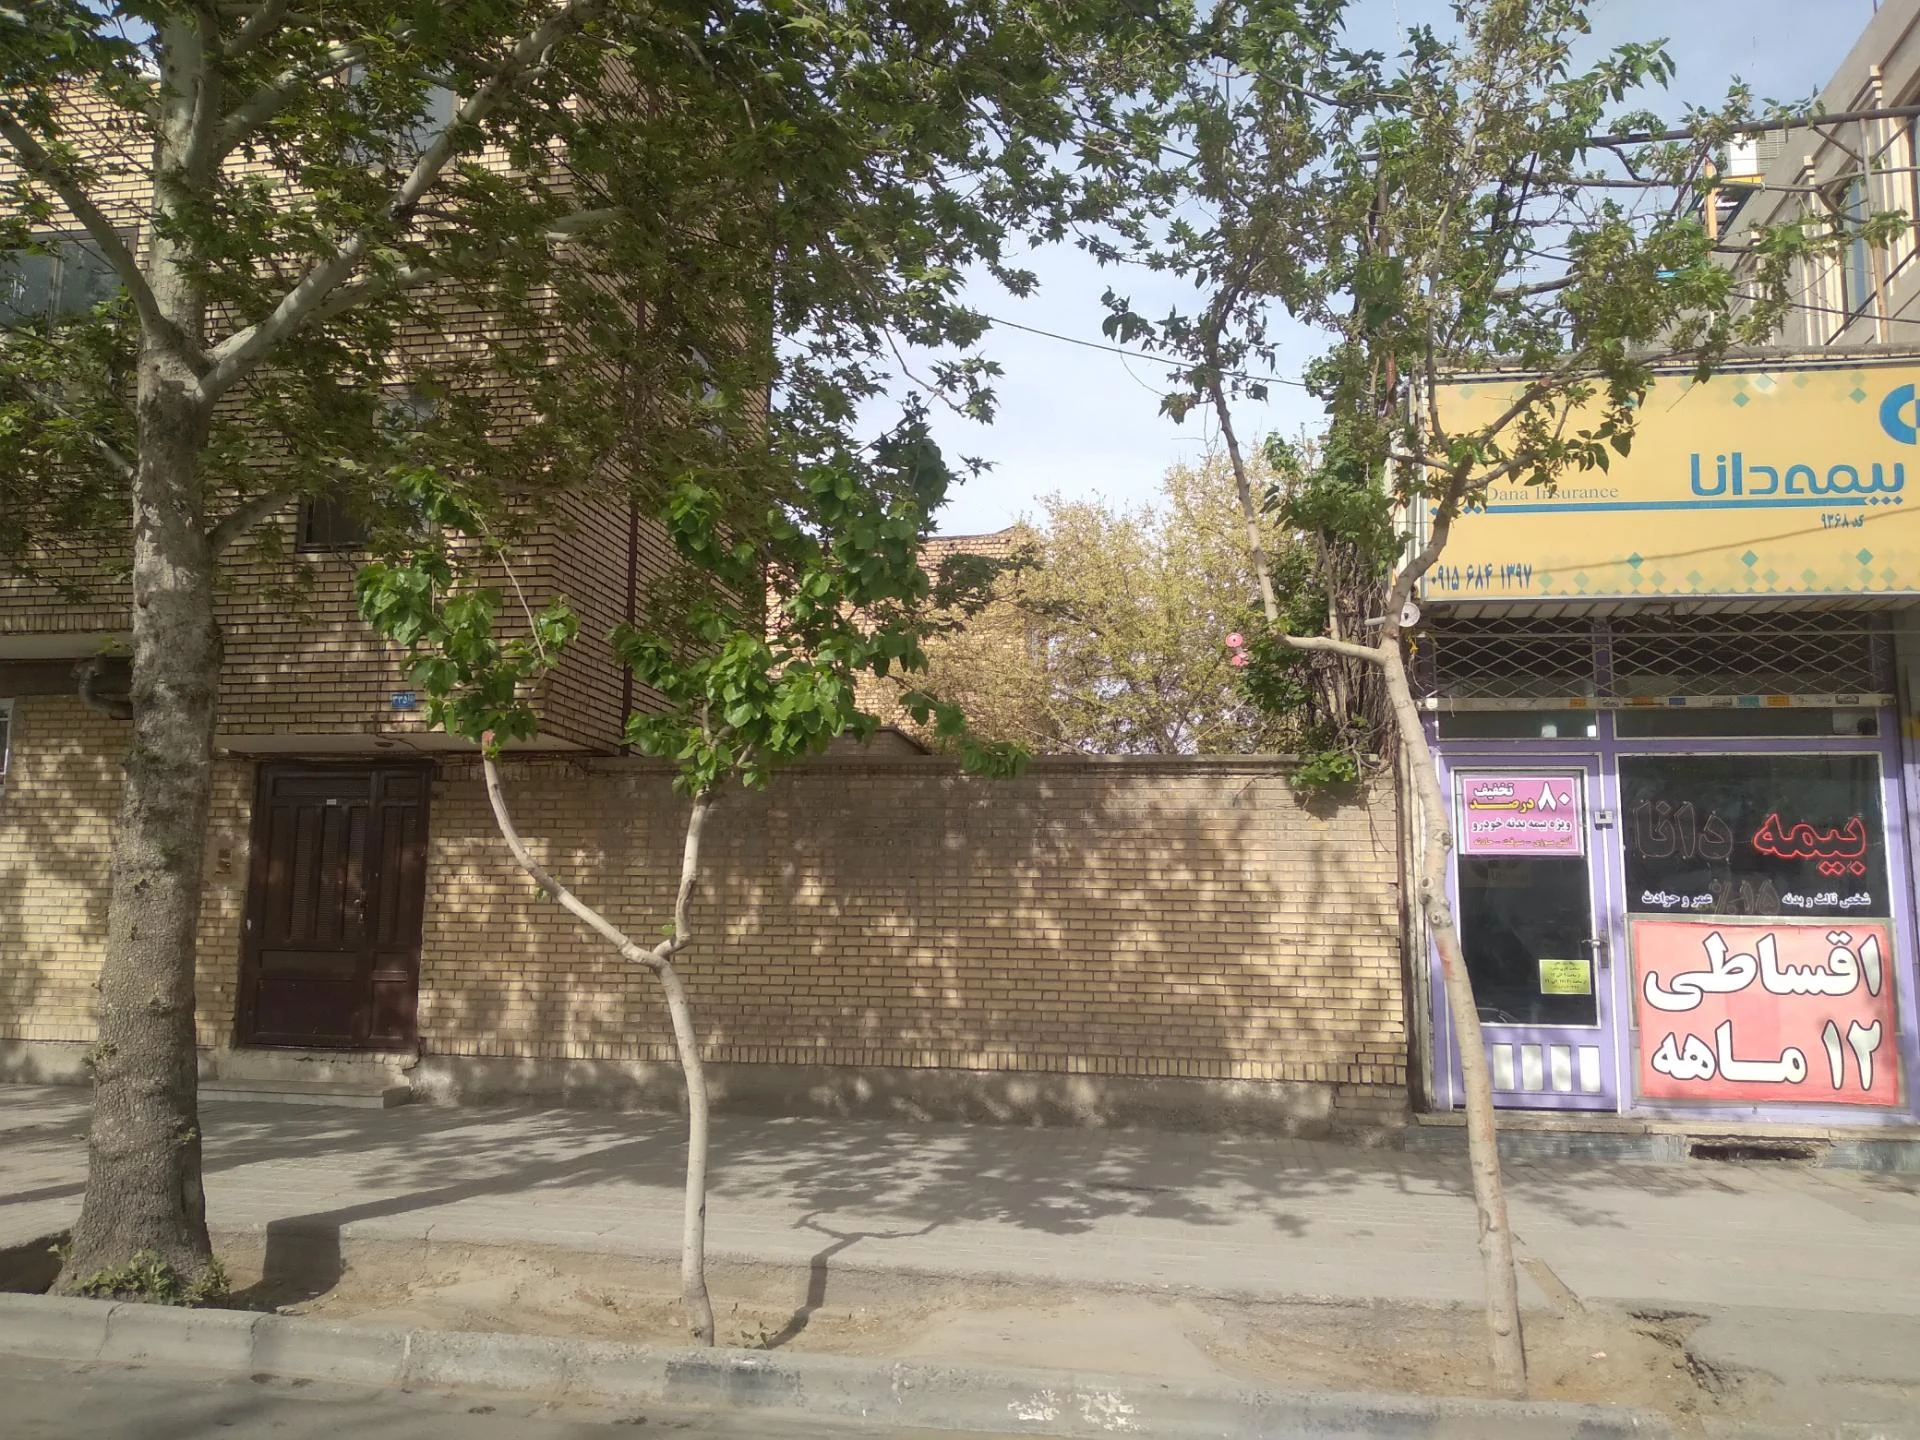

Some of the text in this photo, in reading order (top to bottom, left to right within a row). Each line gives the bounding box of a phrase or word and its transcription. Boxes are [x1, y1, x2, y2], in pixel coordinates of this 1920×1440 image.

[1486, 486, 1529, 501] Dana
[1469, 781, 1571, 814] ۸۰ درصد
[1473, 782, 1515, 800] تخفیف
[1472, 817, 1503, 832] خودرو
[1754, 812, 1867, 877] بیمه
[1643, 931, 1883, 1012] اقساطی
[1651, 1019, 1882, 1091] ۱۲ ماهه
